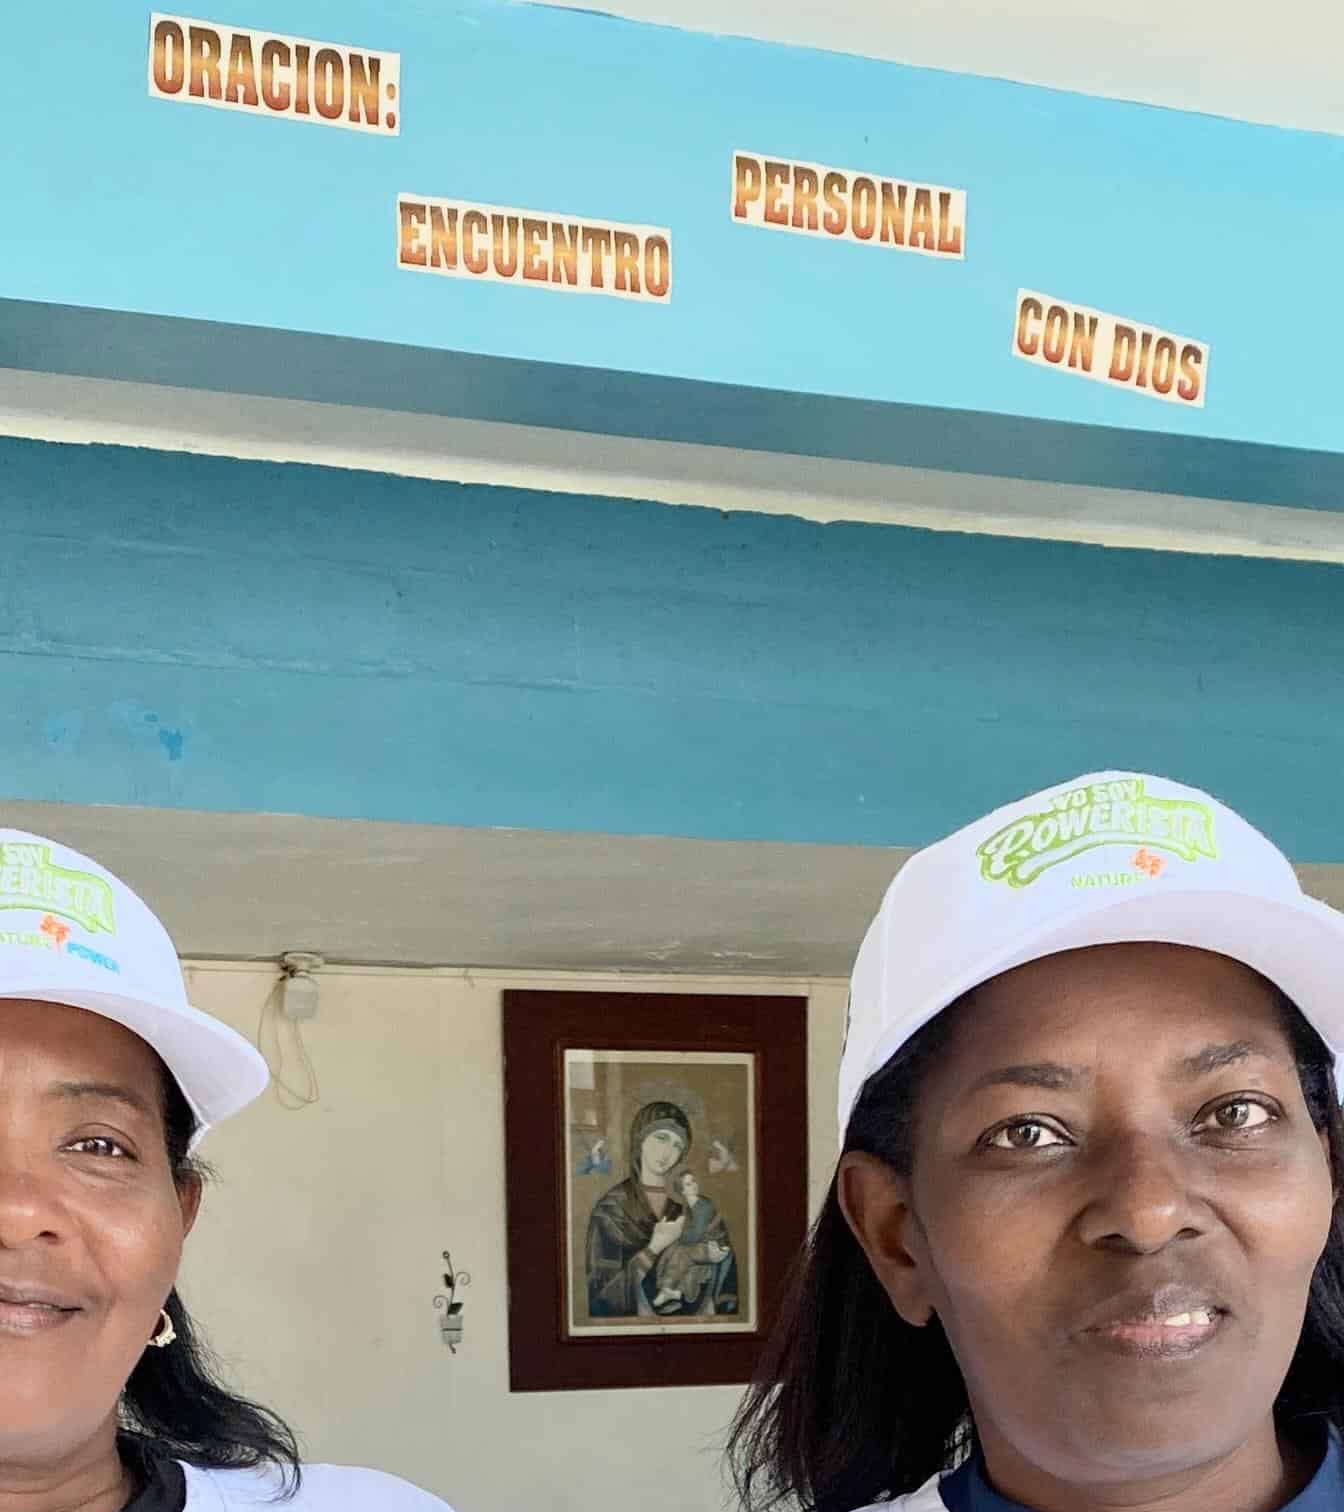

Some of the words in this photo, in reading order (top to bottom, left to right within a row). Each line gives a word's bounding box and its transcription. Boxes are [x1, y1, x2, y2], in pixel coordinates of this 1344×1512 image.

[151, 19, 399, 130] ORACION:
[399, 201, 669, 300] ENCUENTRO
[733, 154, 962, 256] PERSONAL
[1016, 296, 1099, 367] CON
[1109, 322, 1201, 402] DIOS
[1053, 789, 1086, 811] YO
